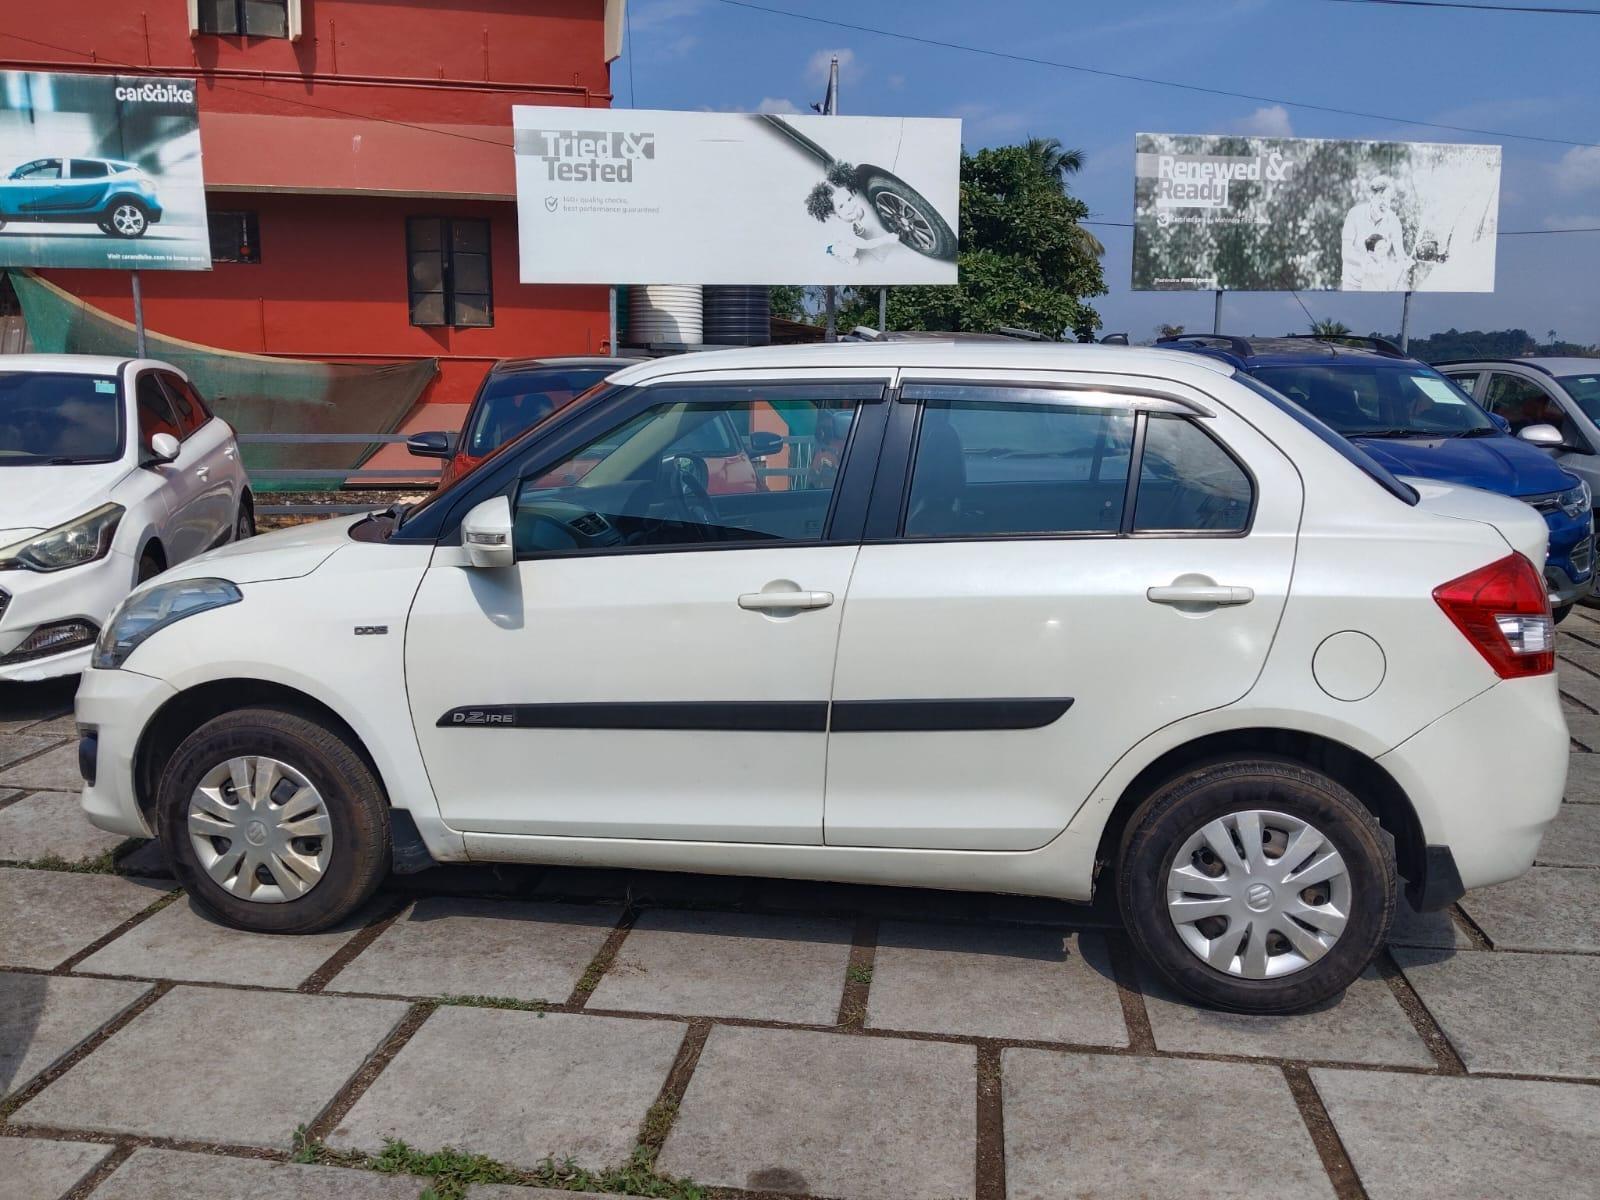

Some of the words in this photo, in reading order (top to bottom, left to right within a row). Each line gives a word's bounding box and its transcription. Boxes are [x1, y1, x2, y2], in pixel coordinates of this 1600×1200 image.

[115, 83, 193, 103] car&bike
[541, 130, 613, 158] Tried
[620, 132, 655, 160] &
[542, 156, 633, 183] Tested
[1158, 155, 1261, 181] Renewed
[1265, 152, 1293, 181] &
[1158, 178, 1227, 206] Ready
